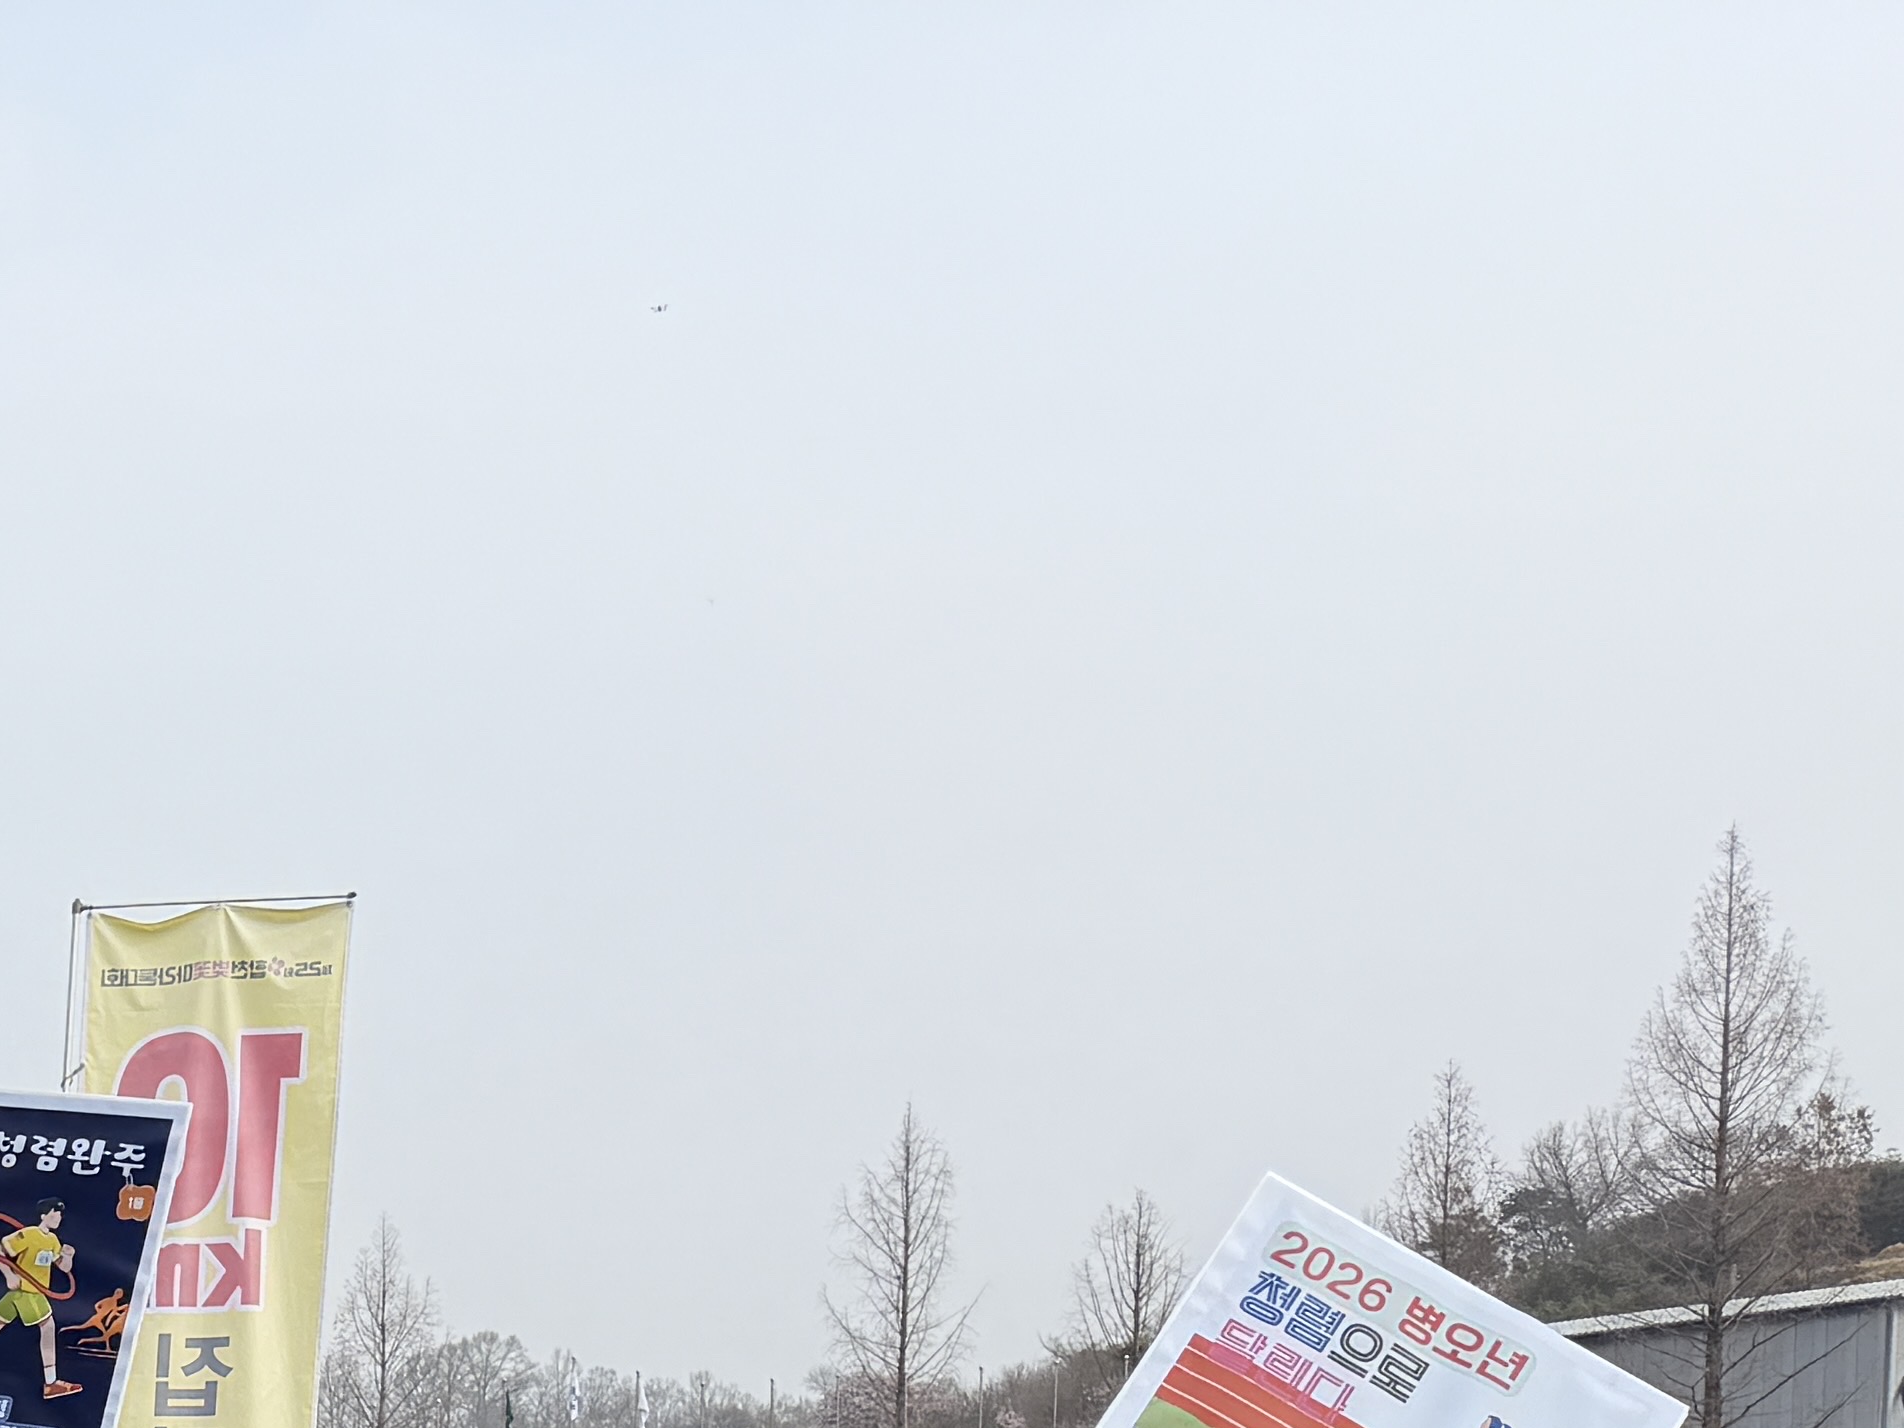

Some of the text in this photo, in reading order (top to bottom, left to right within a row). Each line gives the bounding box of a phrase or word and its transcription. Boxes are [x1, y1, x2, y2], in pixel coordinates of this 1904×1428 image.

[1239, 1269, 1431, 1404] 청렴으로
[1269, 1230, 1529, 1391] 2026 병오년
